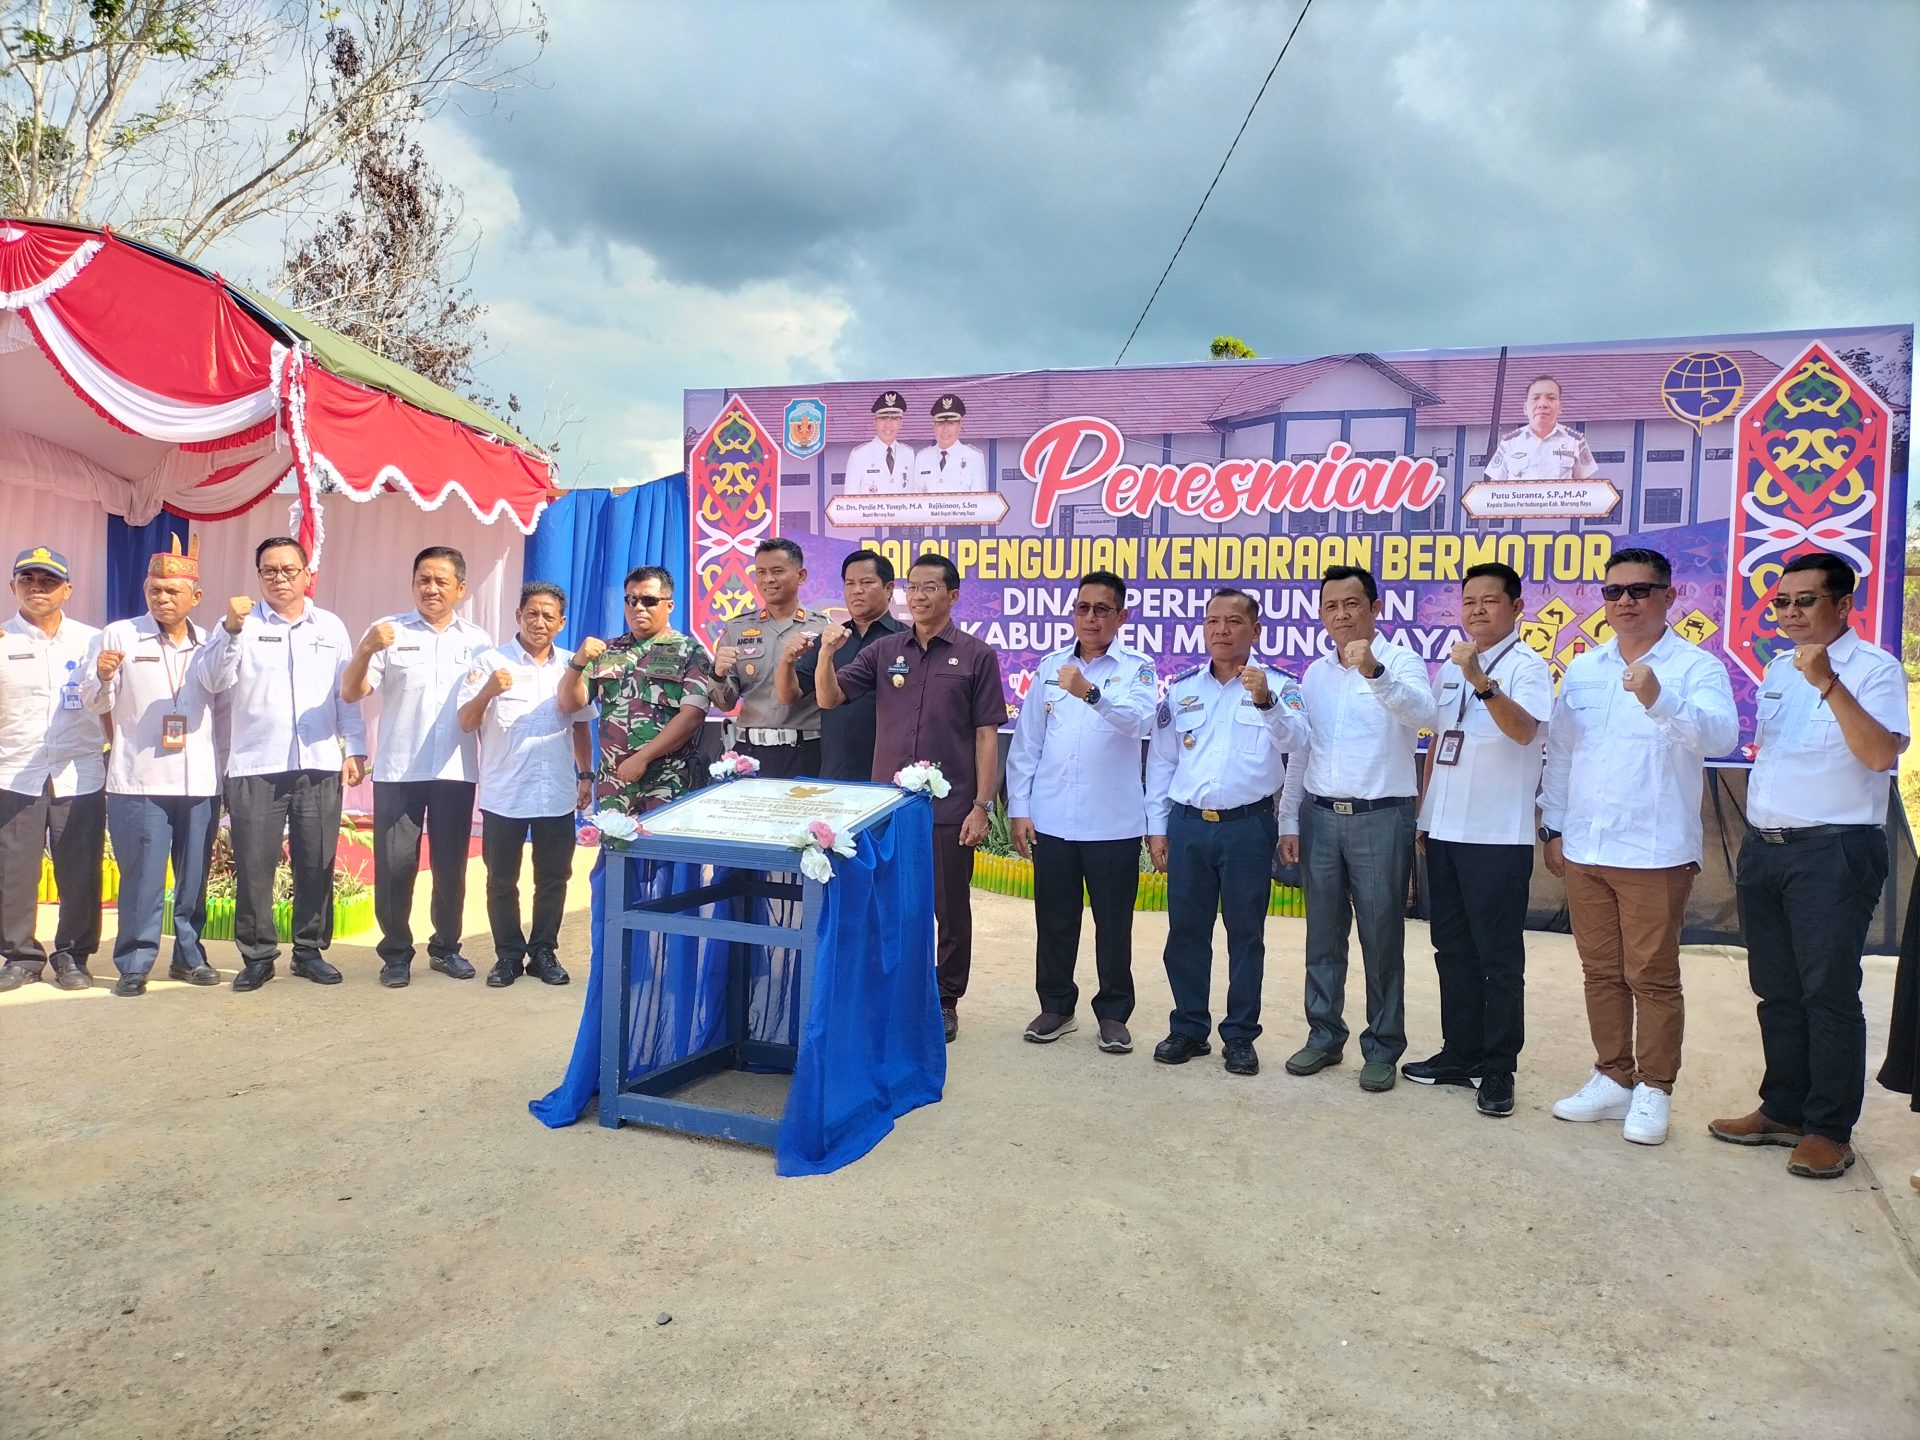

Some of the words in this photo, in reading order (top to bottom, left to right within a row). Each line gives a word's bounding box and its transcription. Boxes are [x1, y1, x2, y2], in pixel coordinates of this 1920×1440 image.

[1021, 417, 1445, 527] Peresmian
[1491, 492, 1510, 500] Putu
[1512, 491, 1544, 500] Suranta,
[956, 537, 1139, 580] PENGUJIAN
[1147, 535, 1373, 580] KENDARAAN
[1381, 533, 1612, 581] BERMOTOR
[1003, 587, 1082, 616] DINA
[1124, 588, 1414, 621] PERHUNN
[959, 621, 1162, 654] KABUPEN
[1173, 624, 1343, 657] MUNG
[1376, 627, 1466, 660] AYA
